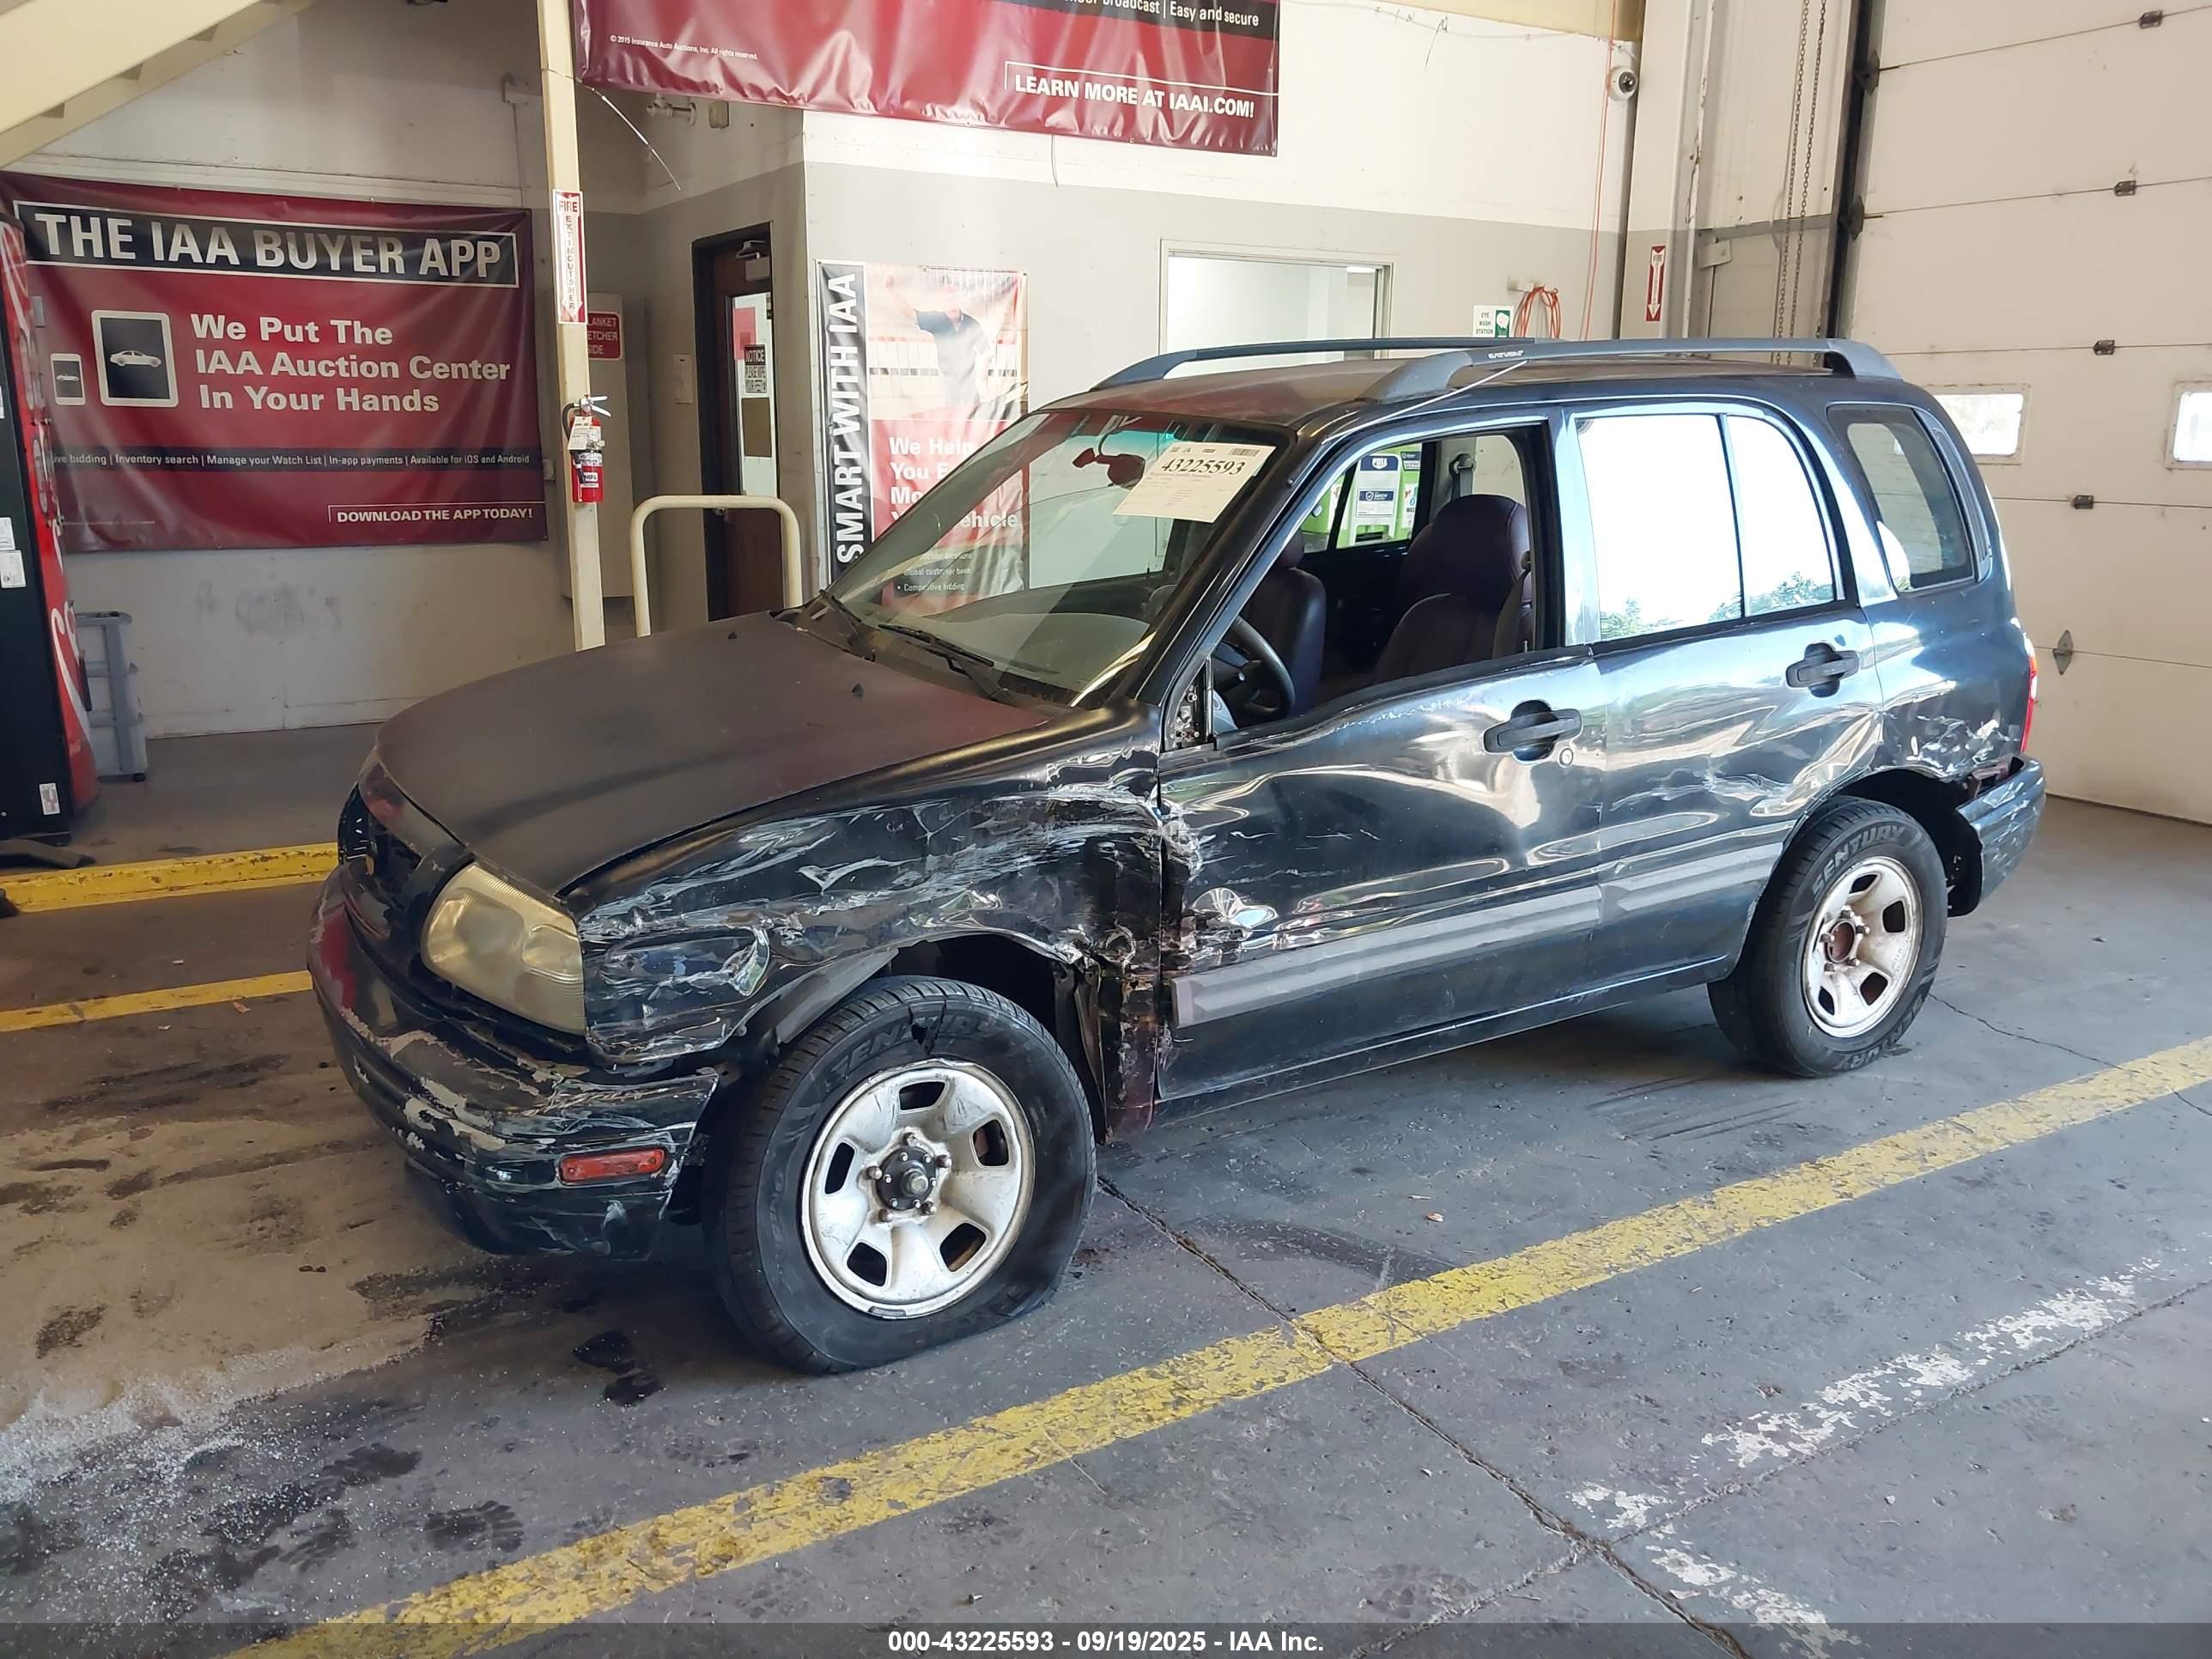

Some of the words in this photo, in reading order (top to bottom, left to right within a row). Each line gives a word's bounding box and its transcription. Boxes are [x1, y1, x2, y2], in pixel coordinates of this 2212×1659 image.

[1170, 7, 1195, 22] Easy
[1199, 9, 1222, 21] and
[1224, 12, 1259, 27] secure
[617, 35, 631, 44] 2015
[631, 38, 659, 48] Insurance
[659, 41, 673, 50] Auto
[720, 49, 734, 58] rights
[1015, 74, 1079, 98] LEARN
[1085, 82, 1138, 105] MORE
[1142, 89, 1165, 108] AT
[1170, 92, 1255, 118] IAAI.COM!
[558, 200, 578, 213] FIRE
[34, 212, 137, 260] THE
[150, 221, 240, 265] IAA
[252, 229, 405, 275] BUYER
[418, 238, 501, 278] APP
[828, 273, 858, 333] IAA
[190, 313, 247, 341] We
[259, 316, 320, 343] Put
[330, 319, 393, 345] The
[588, 317, 617, 326] ANKET
[196, 349, 264, 375] IAA
[270, 351, 399, 379] Auction
[409, 355, 511, 380] Center
[745, 349, 764, 362] NOTICE
[199, 384, 234, 409] In
[243, 386, 325, 410] Your
[336, 387, 440, 412] Hands
[830, 345, 860, 436] WITH
[889, 436, 921, 456] We
[70, 454, 107, 465] bidding
[115, 454, 161, 465] Inventory
[164, 455, 199, 465] search
[206, 455, 246, 466] Manage
[249, 457, 270, 466] your
[271, 455, 303, 465] Watch
[305, 455, 322, 465] List
[329, 455, 358, 467] In-app
[361, 456, 404, 467] payments
[410, 455, 448, 465] Available
[450, 455, 463, 464] for
[481, 455, 495, 464] and
[497, 455, 530, 464] Android
[1161, 458, 1246, 476] 43225593
[890, 462, 929, 481] You
[834, 444, 865, 563] SMART
[337, 510, 422, 523] DOWNLOAD
[422, 509, 450, 520] THE
[453, 508, 483, 520] APP
[483, 507, 533, 519] TODAY!
[960, 510, 1018, 528] ehicle
[1812, 824, 1905, 900] SENTURY
